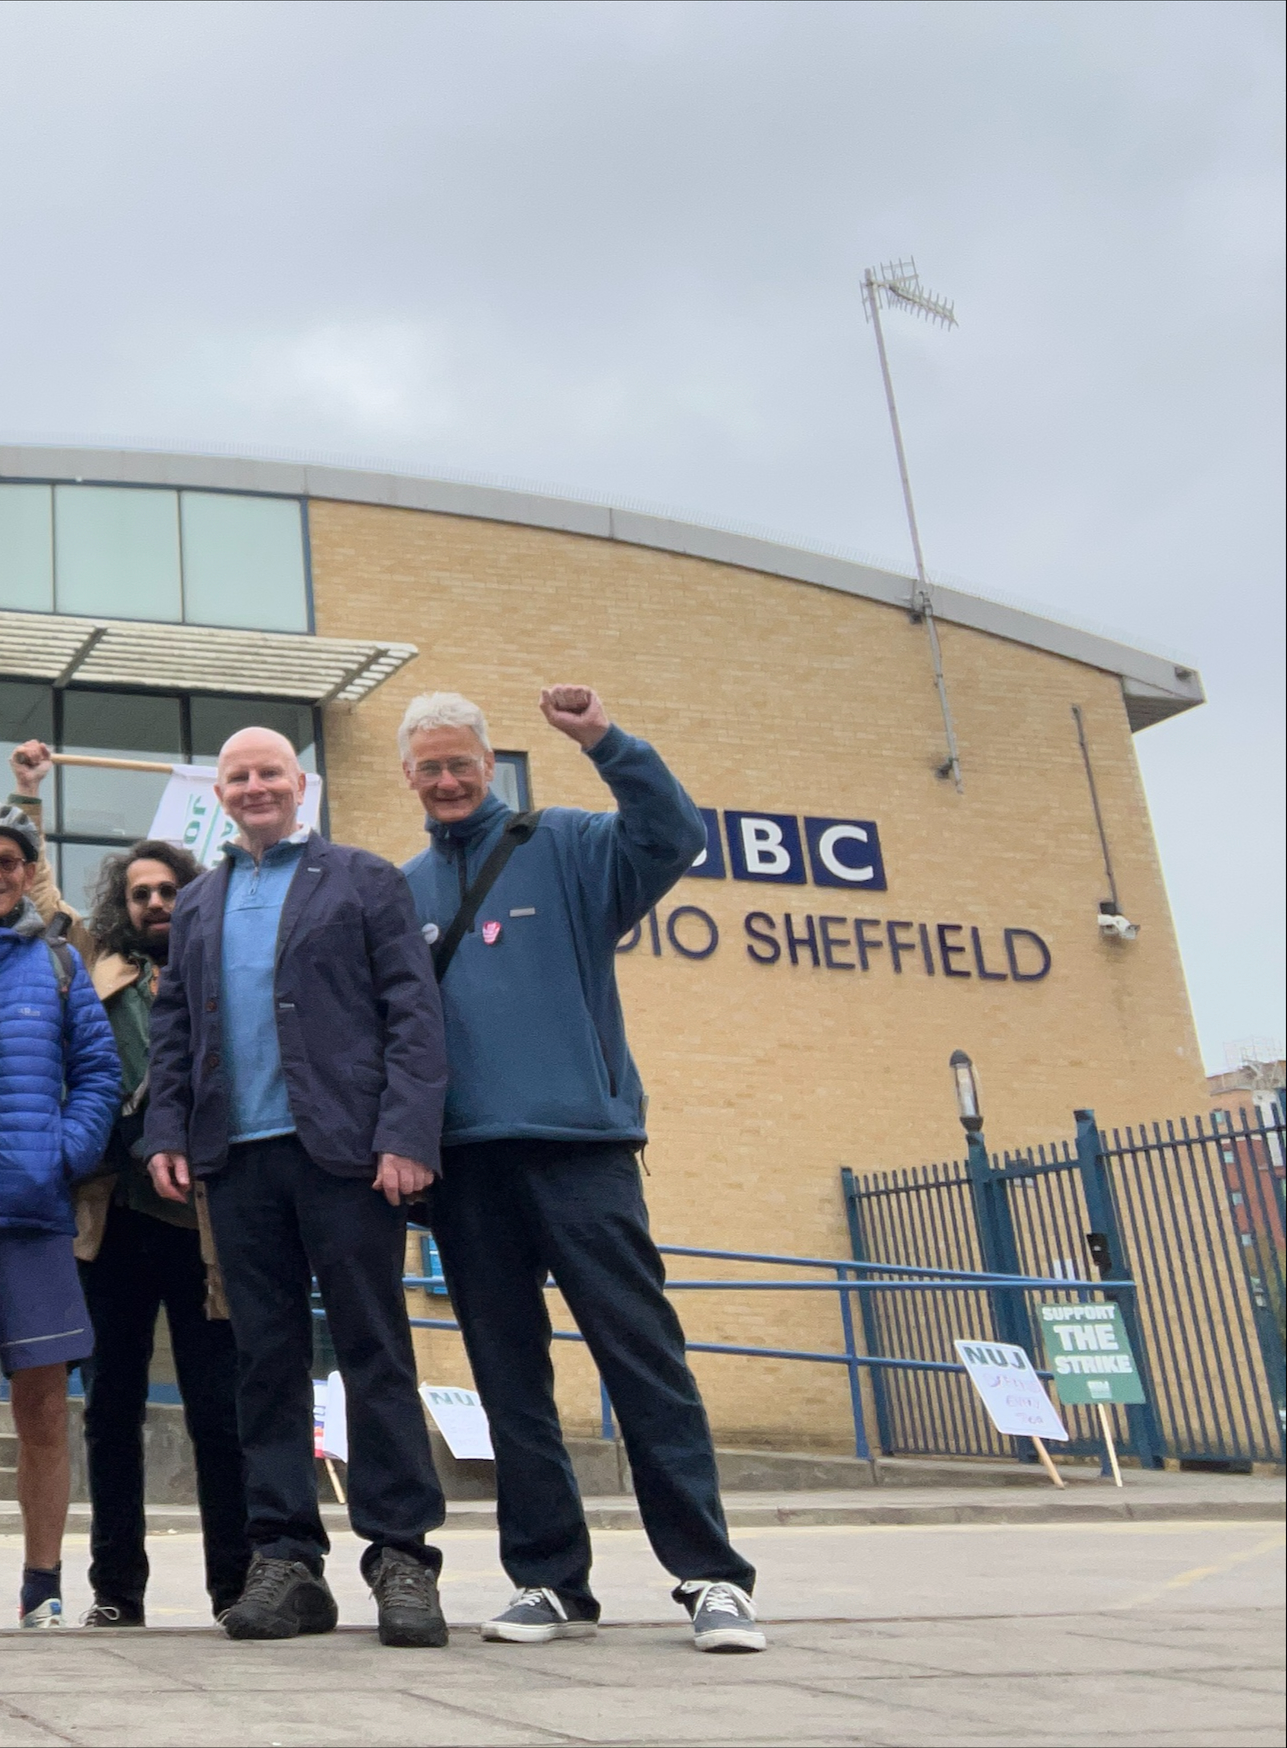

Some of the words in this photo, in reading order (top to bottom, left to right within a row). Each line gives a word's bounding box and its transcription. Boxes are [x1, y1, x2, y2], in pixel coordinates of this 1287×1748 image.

[692, 817, 874, 881] BC
[744, 911, 1052, 983] SHEFFIELD
[1042, 1305, 1115, 1321] SUPPORT
[1053, 1323, 1119, 1350] THE
[963, 1346, 1026, 1370] NUJ
[1054, 1355, 1133, 1374] STRIKE
[428, 1392, 475, 1406] NU
